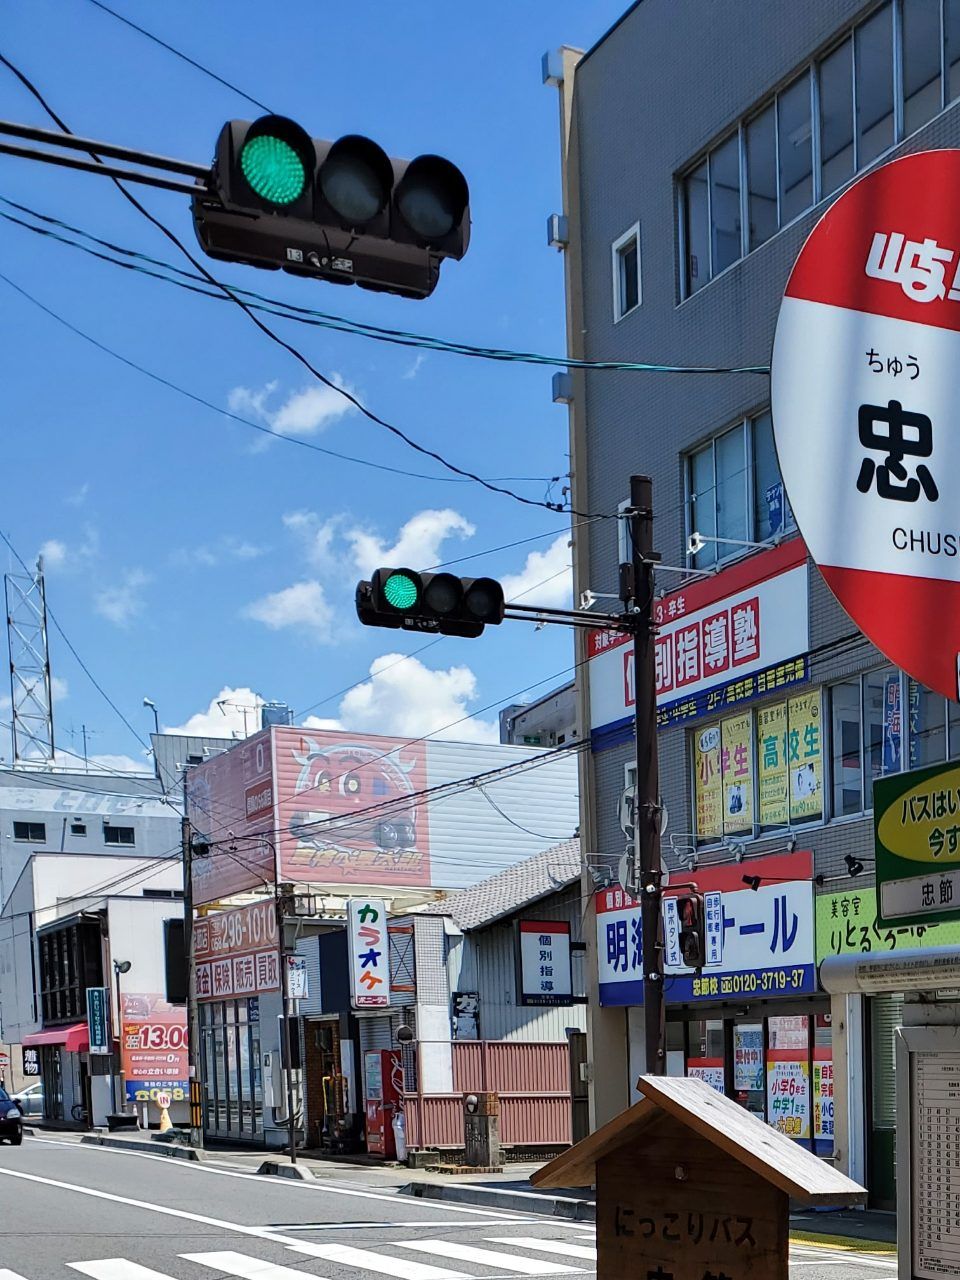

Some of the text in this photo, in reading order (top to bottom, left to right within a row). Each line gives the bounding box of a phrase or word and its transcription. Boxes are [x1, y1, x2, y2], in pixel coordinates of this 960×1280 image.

[866, 347, 920, 380] ちゅう
[626, 605, 757, 703] 別指導塾
[700, 743, 749, 786] 小学生
[763, 722, 820, 770] 高校生
[831, 896, 861, 919] 美容室
[921, 879, 953, 906] 忠節
[222, 903, 277, 948] 296-1010
[357, 903, 383, 990] カラオケ
[538, 934, 554, 992] 個別指導
[215, 962, 231, 993] 保険
[235, 957, 253, 989] 販売
[258, 955, 278, 986] 買取
[733, 969, 805, 993] 0120-3719-37
[160, 1096, 169, 1104] IN
[772, 1078, 805, 1097] 小学6年生
[772, 1097, 805, 1115] 中学1年生
